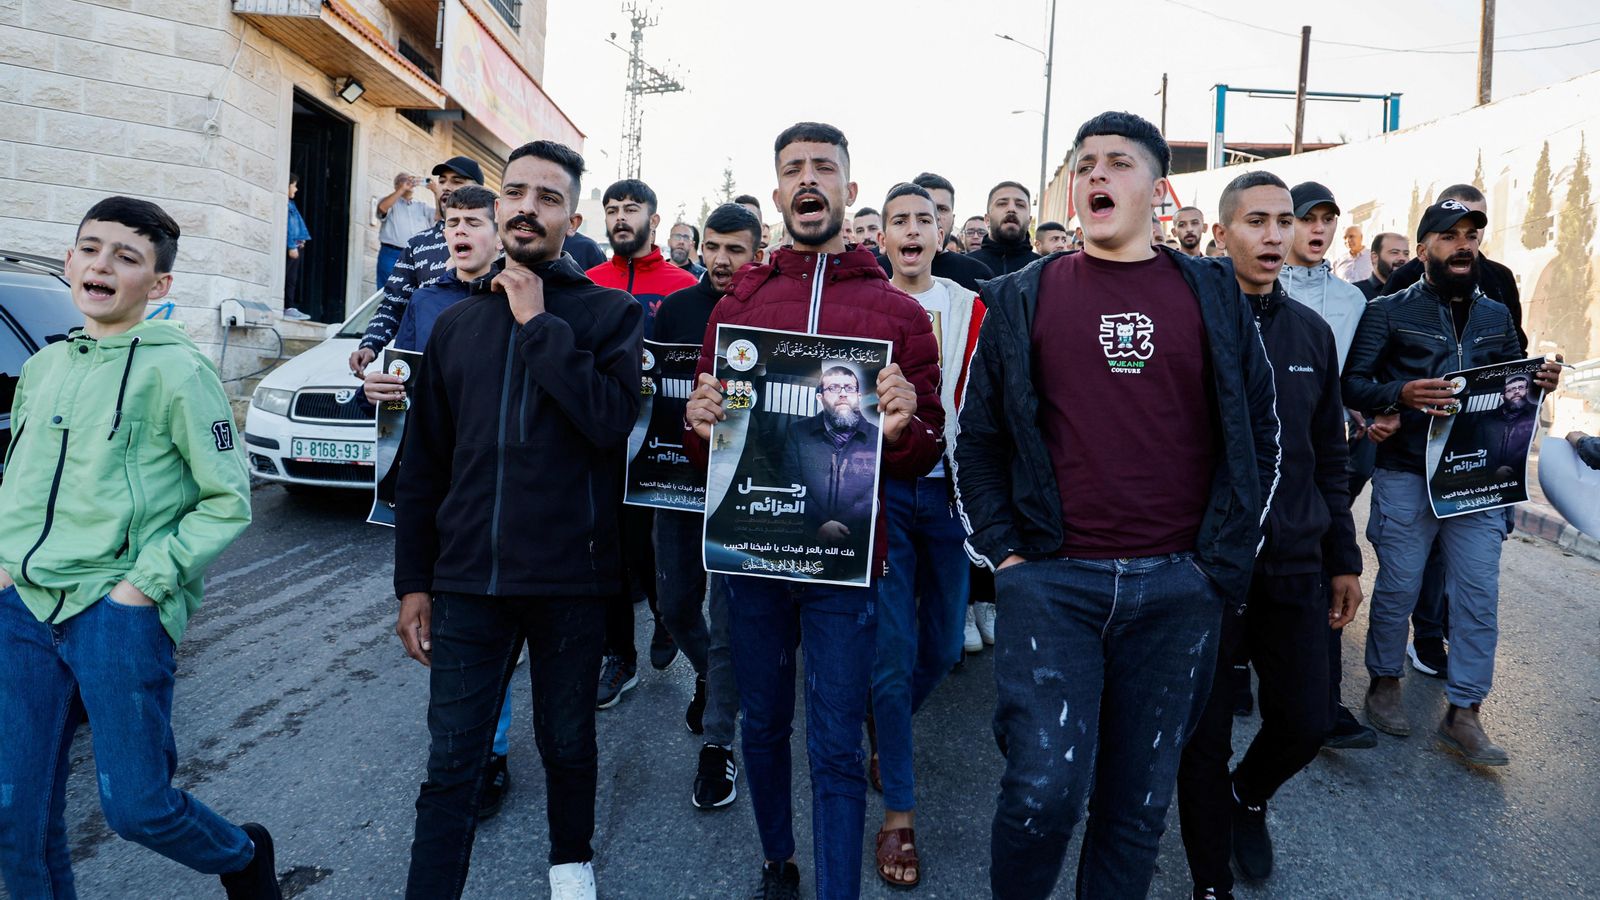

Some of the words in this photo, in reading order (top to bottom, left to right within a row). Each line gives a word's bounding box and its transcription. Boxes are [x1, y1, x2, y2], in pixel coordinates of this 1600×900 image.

[1108, 360, 1145, 368] WJEANS
[213, 421, 233, 450] 17
[738, 477, 807, 498] رجل
[749, 496, 805, 516] العزائم
[773, 544, 780, 553] يا
[824, 547, 839, 555] الله
